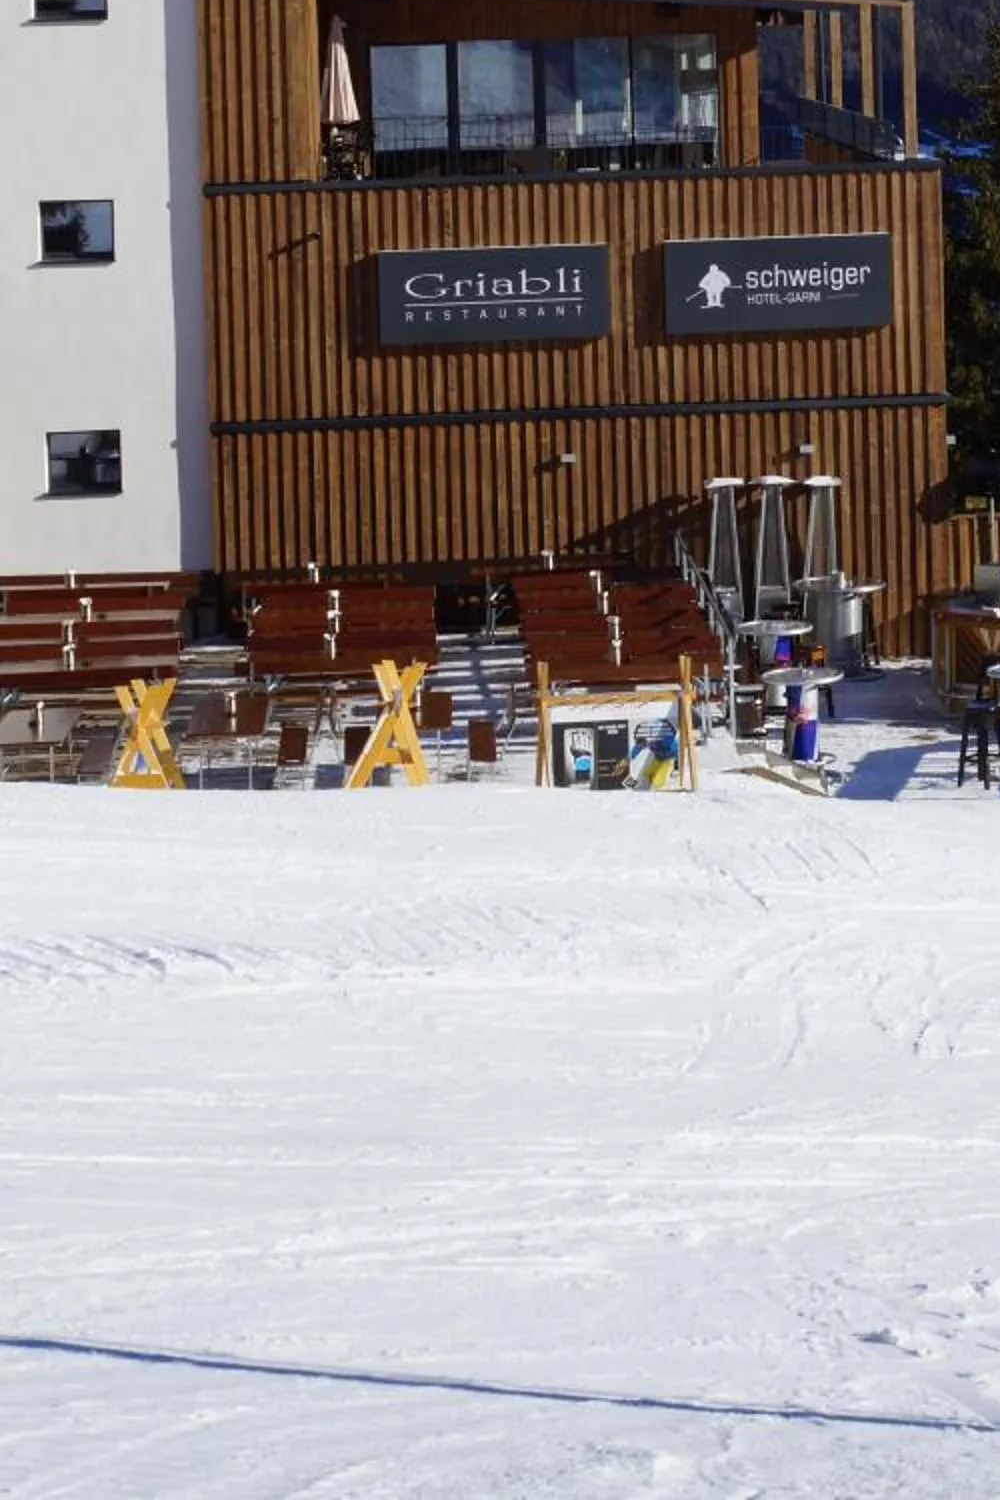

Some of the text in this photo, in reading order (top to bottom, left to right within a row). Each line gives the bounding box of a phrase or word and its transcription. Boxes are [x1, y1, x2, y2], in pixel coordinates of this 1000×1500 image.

[404, 266, 583, 299] Griabli
[745, 261, 871, 291] schweiger
[404, 304, 583, 323] RESTAURANT
